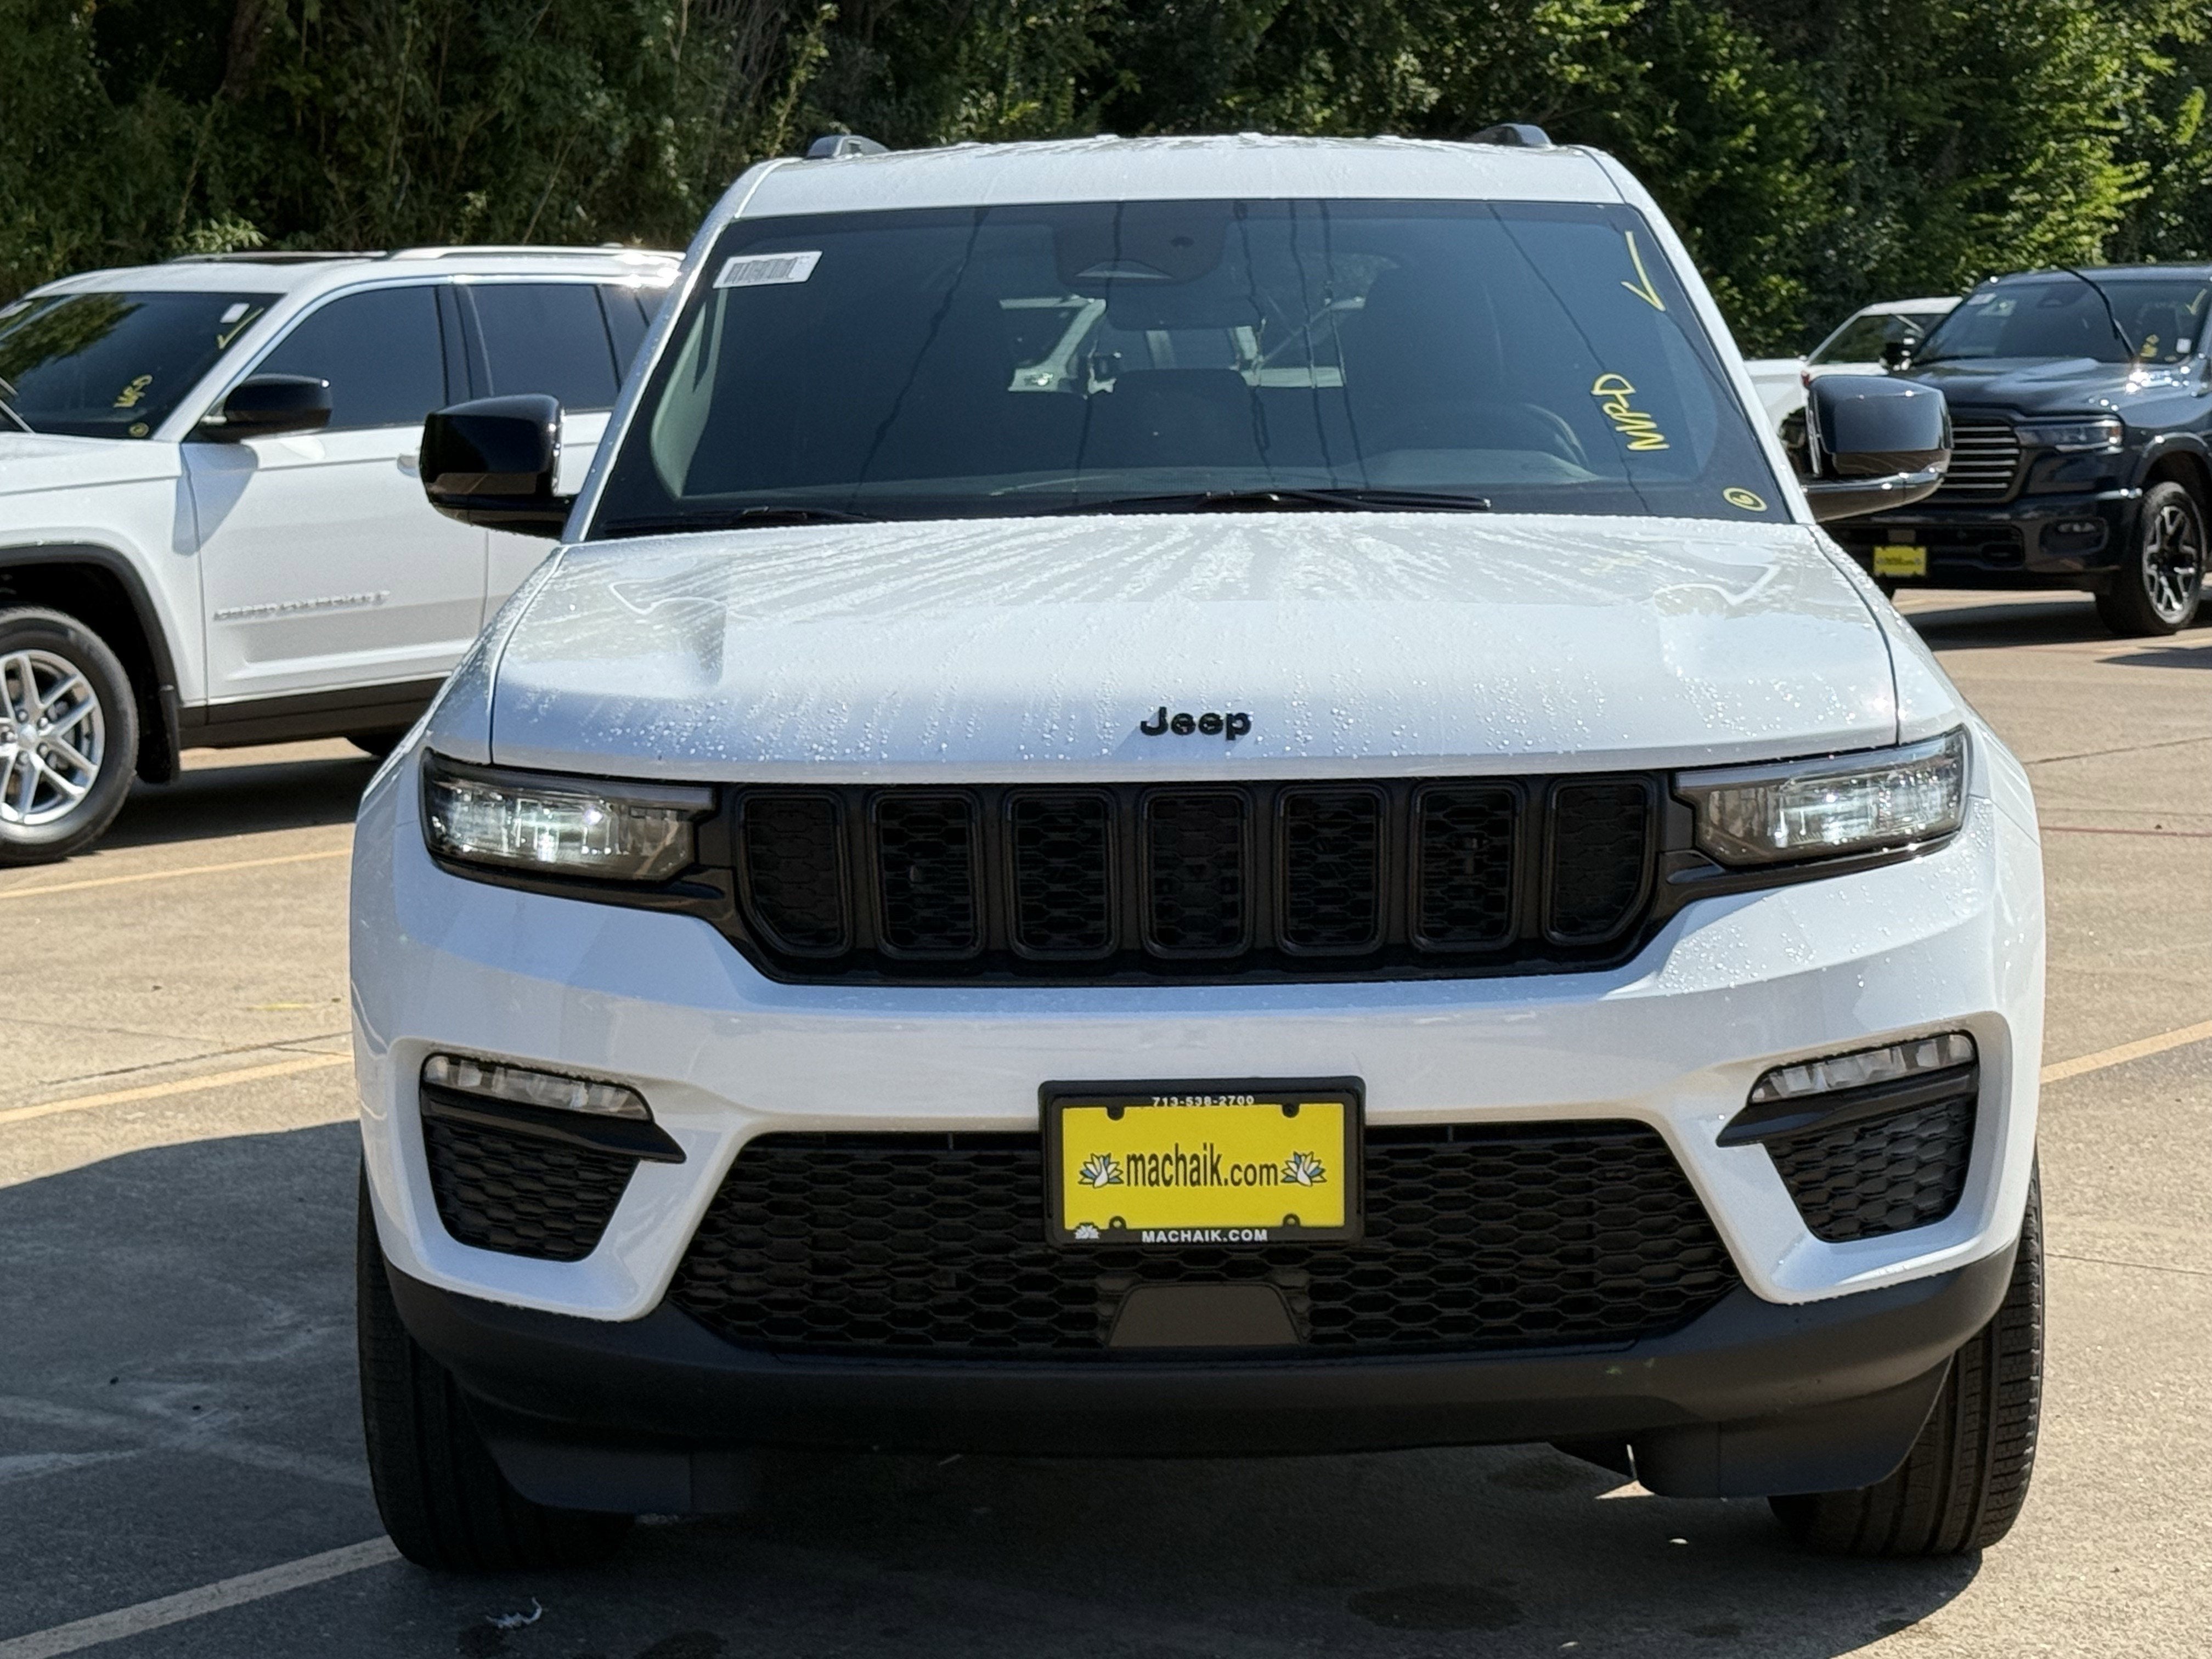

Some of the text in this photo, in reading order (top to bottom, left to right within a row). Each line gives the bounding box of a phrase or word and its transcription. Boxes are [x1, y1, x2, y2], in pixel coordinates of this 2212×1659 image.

[1140, 707, 1251, 741] Jeep
[1152, 1095, 1255, 1107] 713-538-2700
[1126, 1143, 1279, 1187] machaik.com
[1142, 1229, 1268, 1243] MACHAIK.COM
